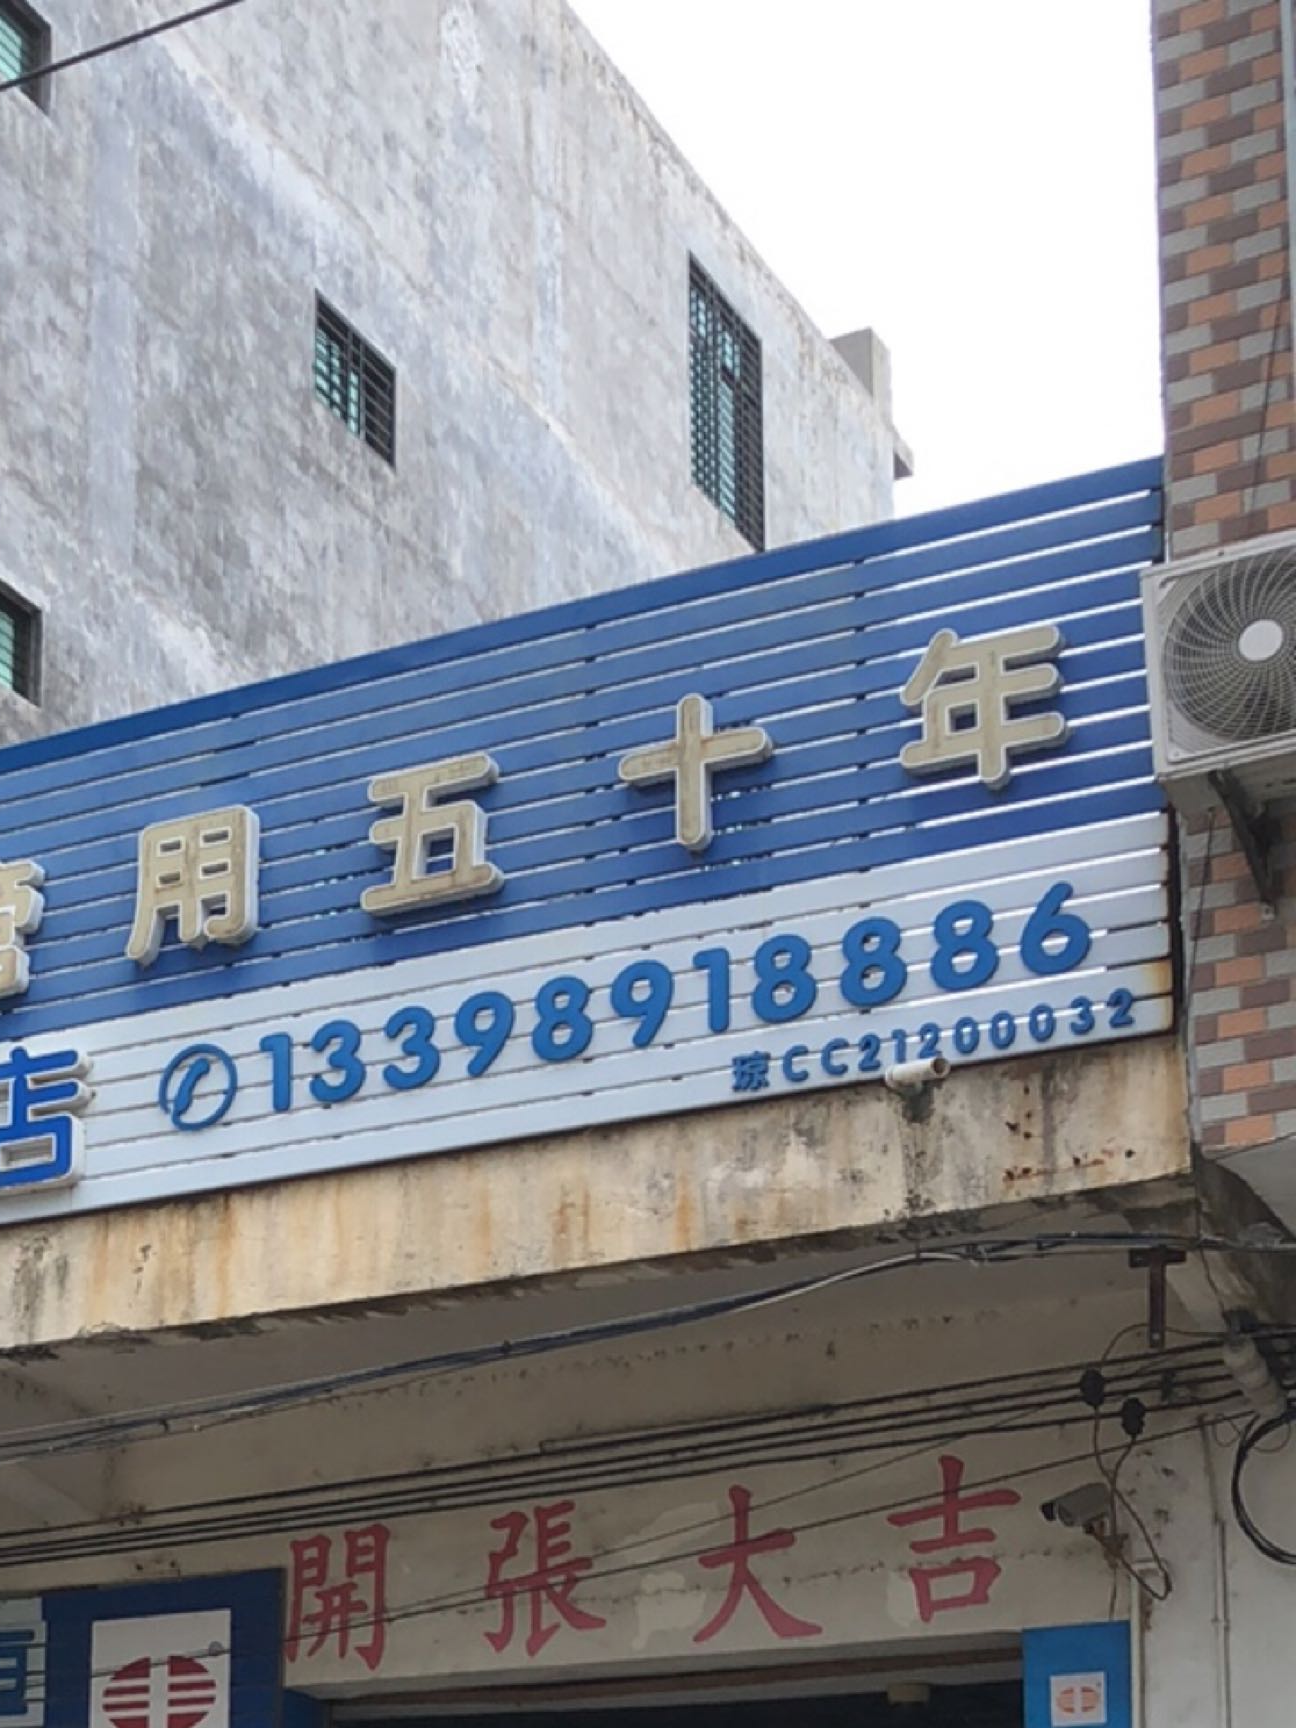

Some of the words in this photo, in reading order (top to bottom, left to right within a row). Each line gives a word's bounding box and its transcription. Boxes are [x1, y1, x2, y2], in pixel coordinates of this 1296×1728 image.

[259, 881, 1092, 1112] 13398918886
[285, 1454, 1021, 1671] 開張大吉
